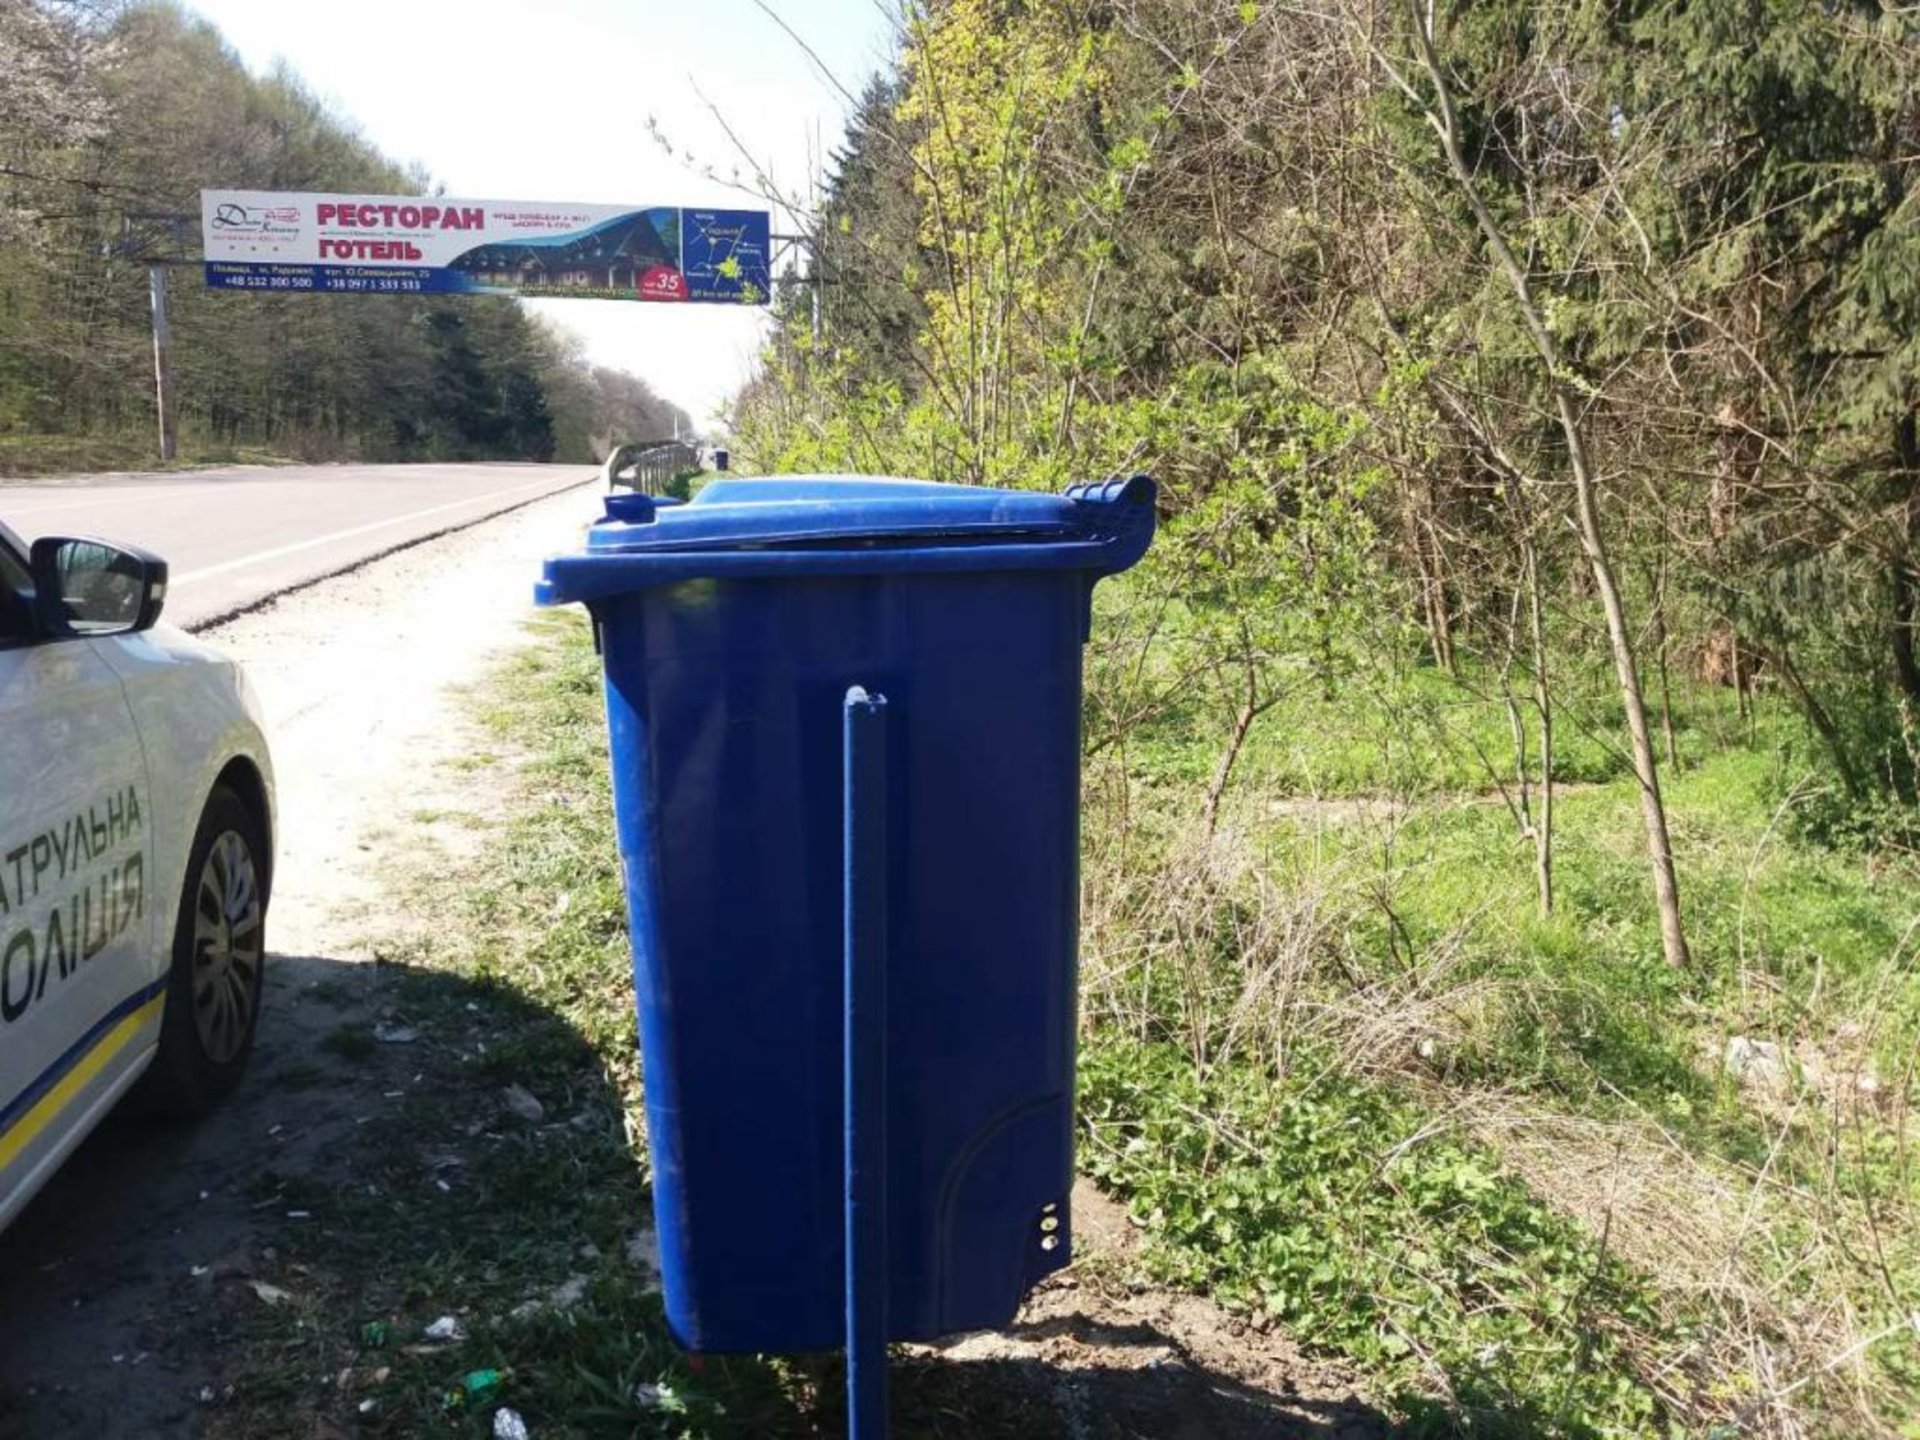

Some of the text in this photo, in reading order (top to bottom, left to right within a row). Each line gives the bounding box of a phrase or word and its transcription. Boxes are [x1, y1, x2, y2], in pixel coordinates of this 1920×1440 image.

[317, 203, 484, 230] РЕСТОРАН
[319, 239, 423, 261] ГОТЕЛЬ
[656, 272, 679, 291] 35
[1, 852, 143, 1023] ОЛІЦІЯ
